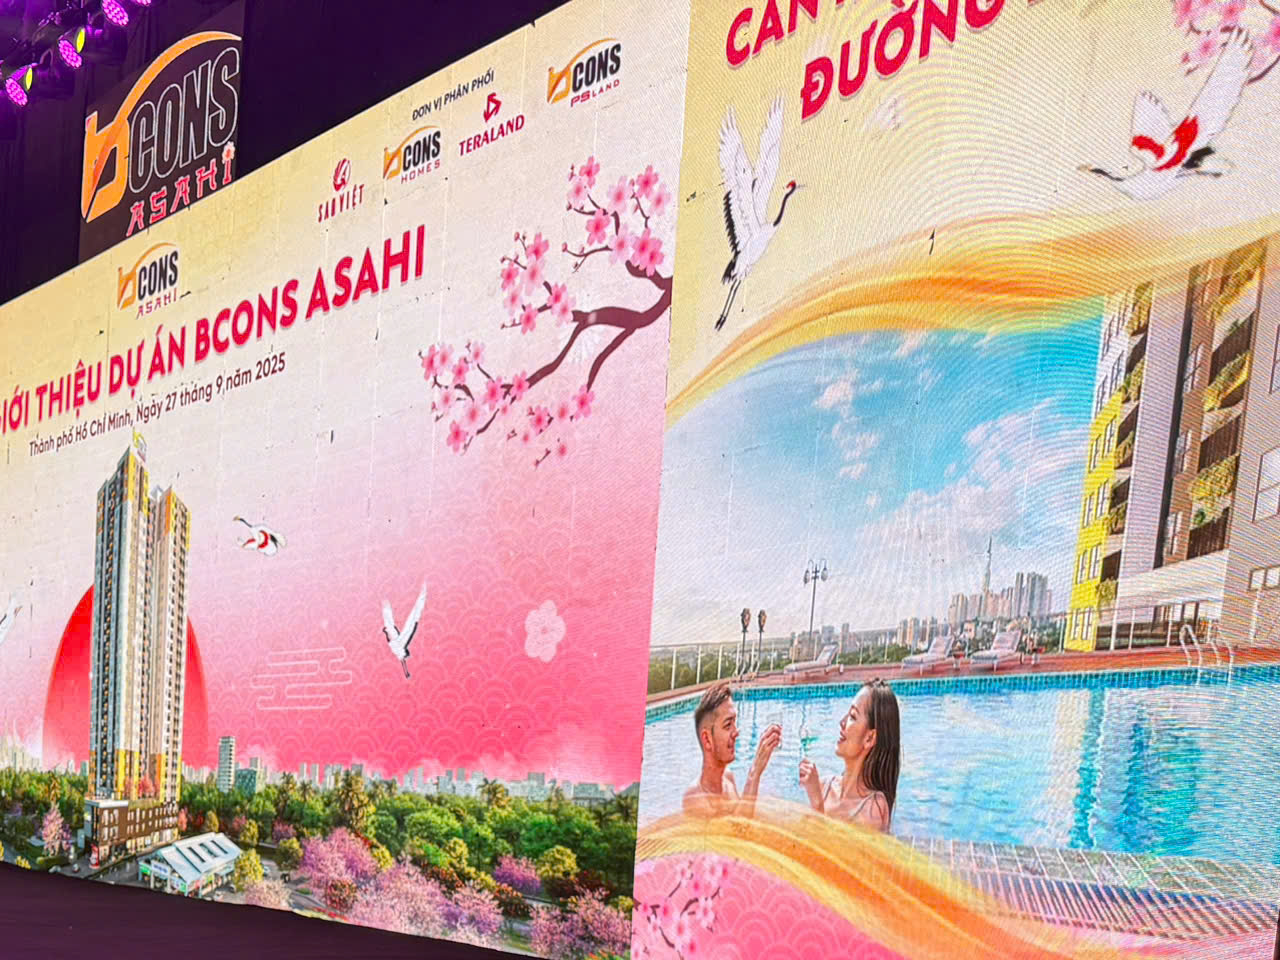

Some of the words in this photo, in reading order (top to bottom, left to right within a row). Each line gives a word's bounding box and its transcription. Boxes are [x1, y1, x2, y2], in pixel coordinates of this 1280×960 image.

[459, 114, 525, 156] TERALAND
[126, 141, 236, 237] ASAHI
[401, 159, 441, 184] HOMES
[36, 359, 102, 422] THIỆU
[109, 338, 145, 399] DỰ
[147, 324, 186, 382] ÁN
[195, 279, 299, 363] BCONS
[304, 224, 426, 320] ASAHI
[136, 287, 177, 320] ASAHI
[136, 400, 163, 424] Ngày
[165, 392, 177, 412] 27
[179, 384, 213, 407] tháng
[216, 375, 223, 394] 9
[225, 367, 252, 391] năm
[255, 352, 286, 381] 2025
